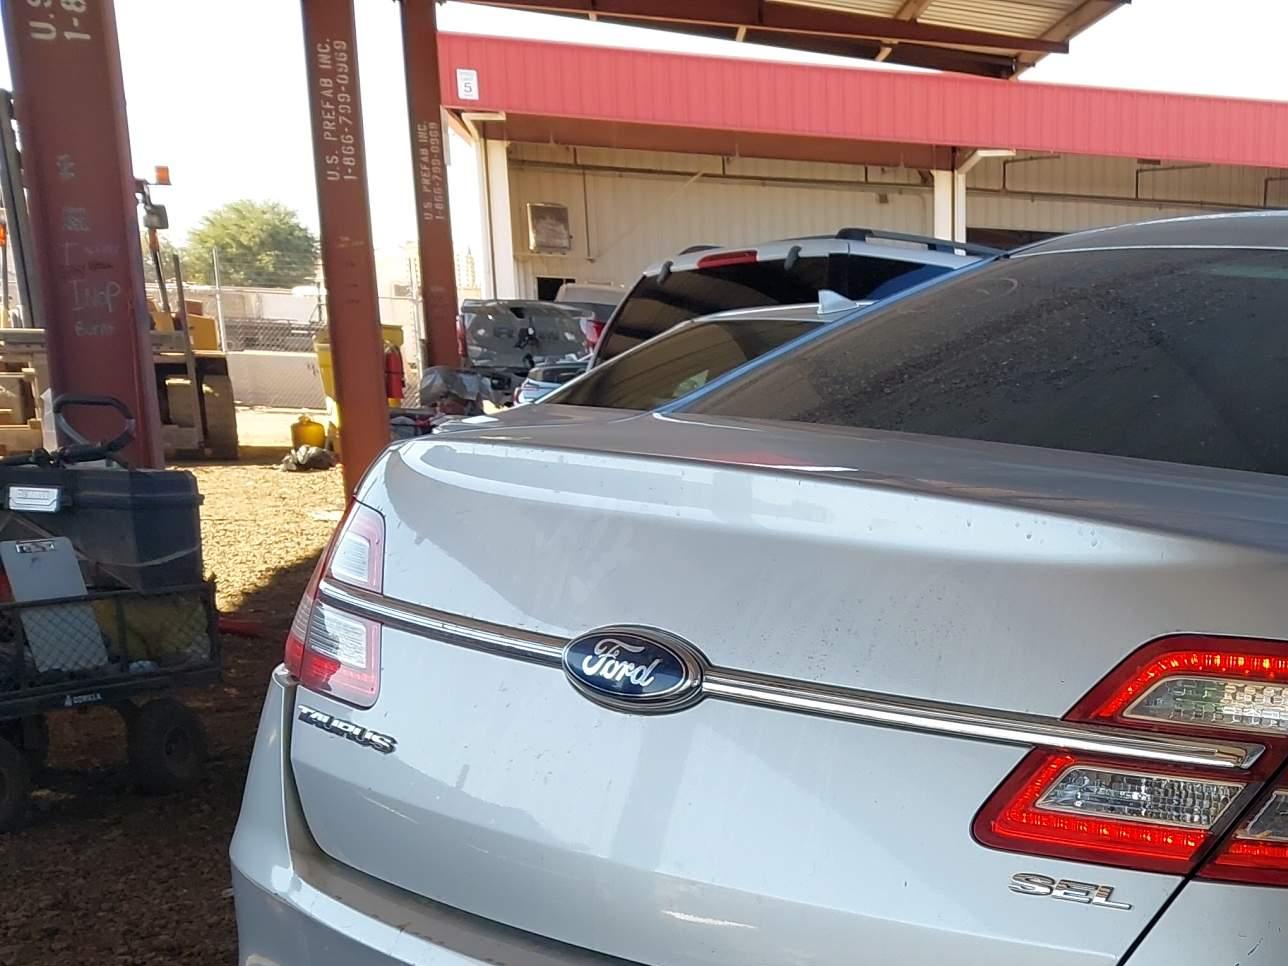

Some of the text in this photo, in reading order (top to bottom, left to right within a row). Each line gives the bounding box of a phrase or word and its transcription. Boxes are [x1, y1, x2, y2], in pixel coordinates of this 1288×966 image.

[316, 37, 341, 181] U.S. PREFAB INC.
[332, 40, 359, 180] 1-866-799-0969
[463, 82, 473, 93] 5
[419, 147, 432, 193] PREFAB
[582, 638, 664, 687] Ford
[1008, 873, 1133, 911] SEL
